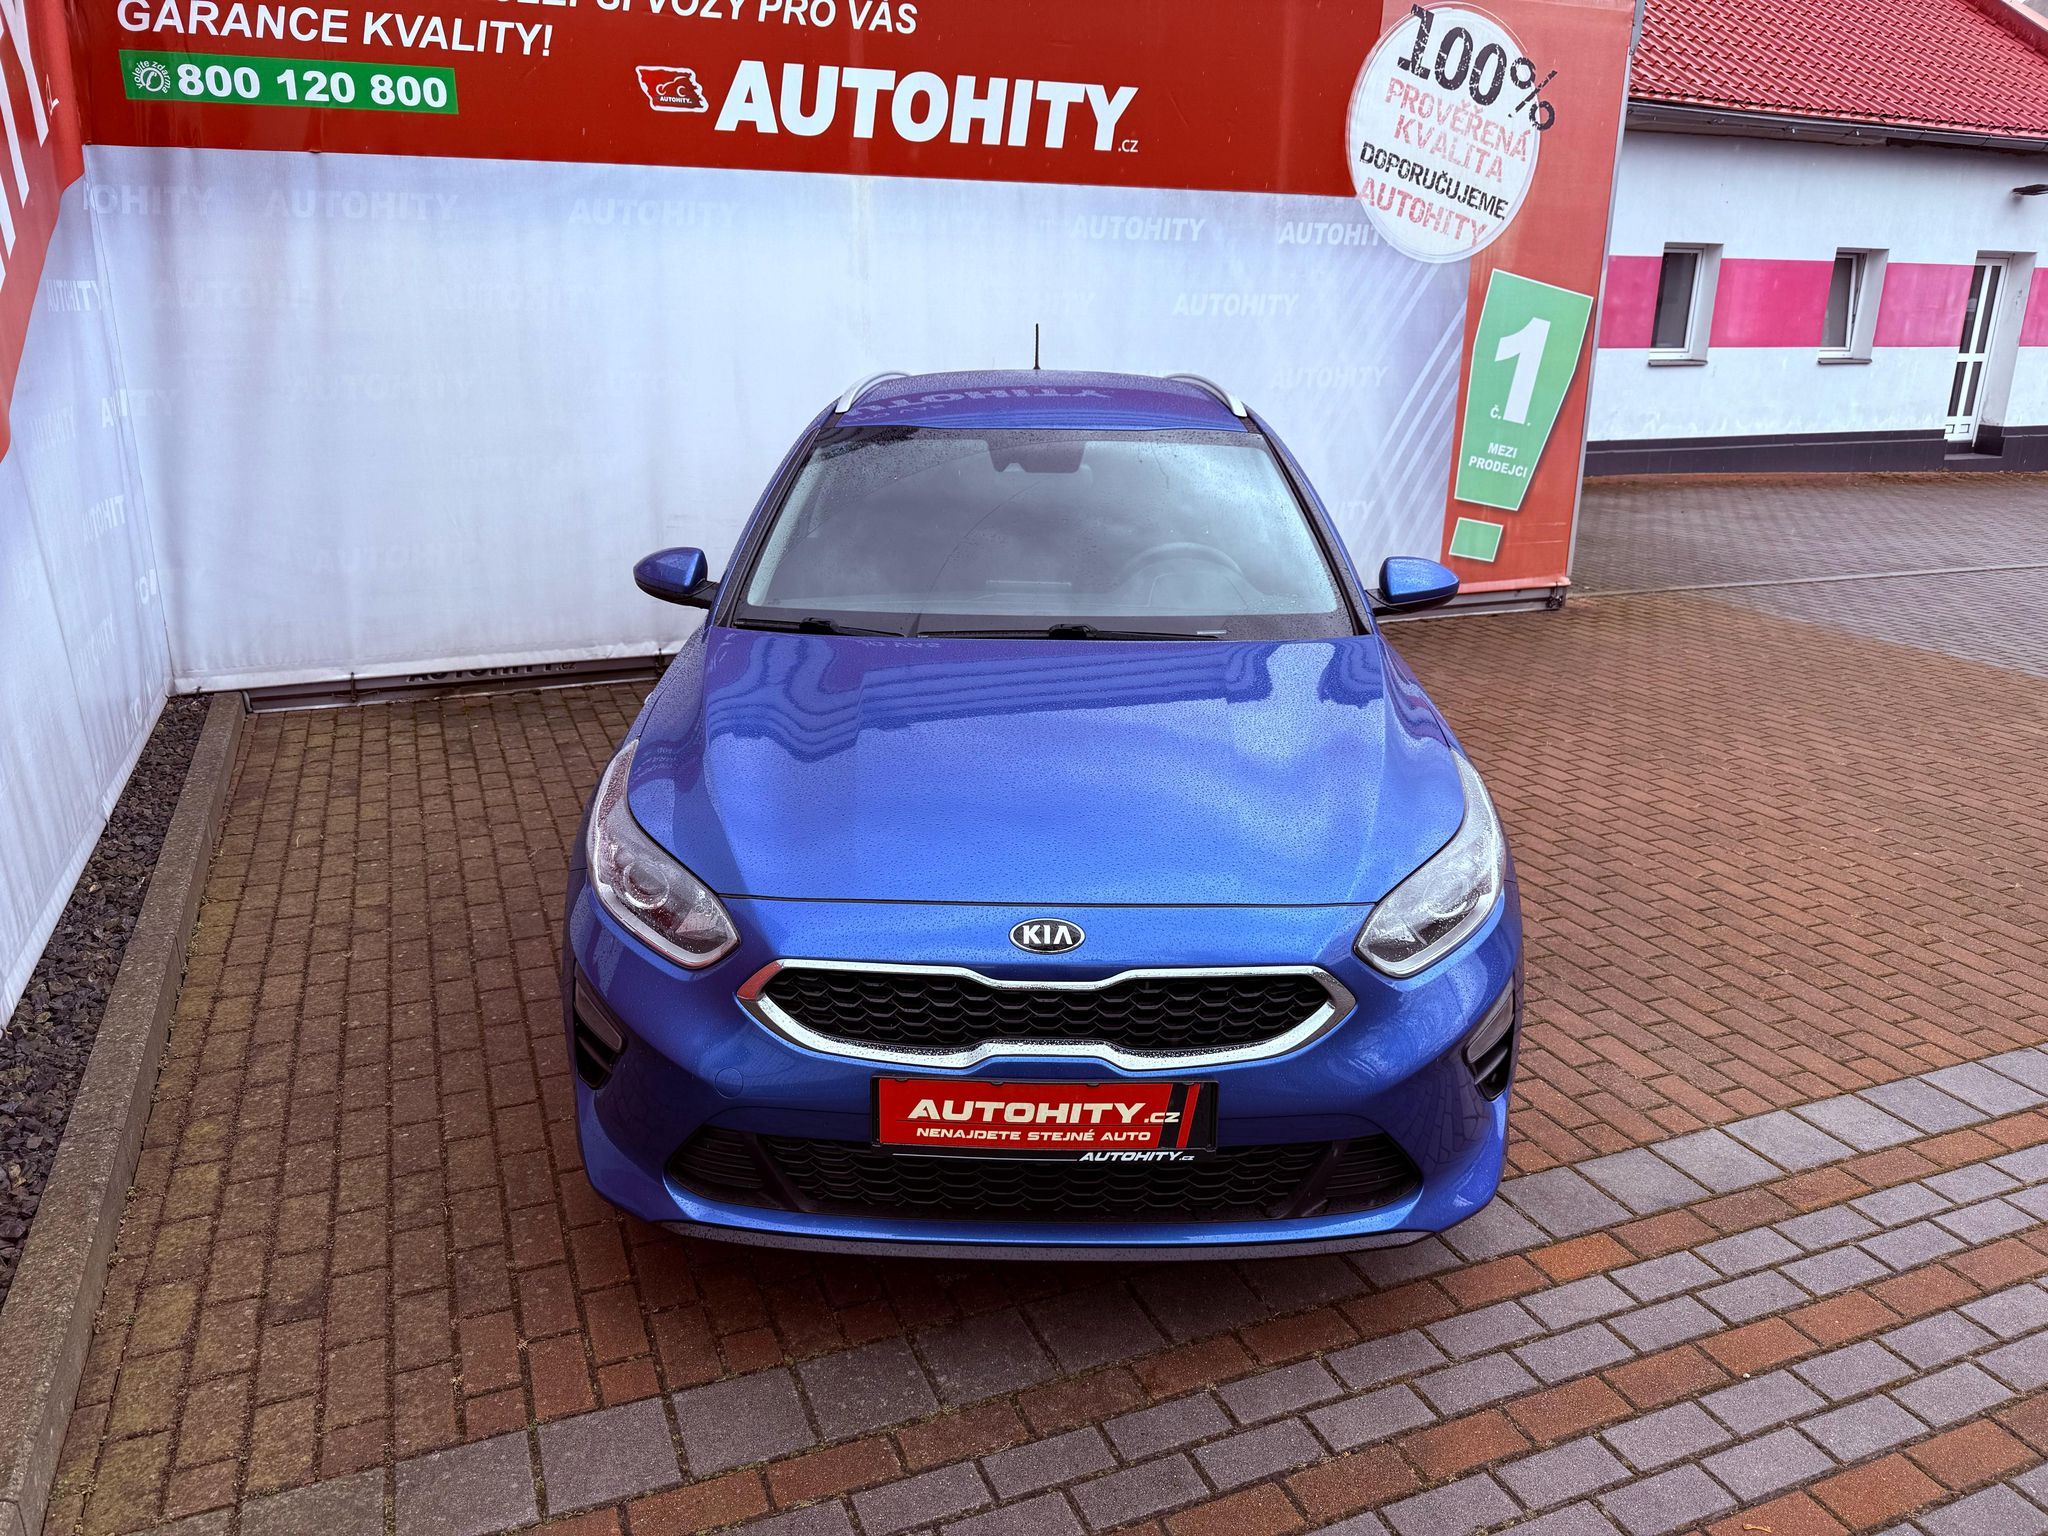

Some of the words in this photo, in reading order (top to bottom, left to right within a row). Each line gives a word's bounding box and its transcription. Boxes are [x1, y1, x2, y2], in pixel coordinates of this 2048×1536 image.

[116, 0, 349, 43] GARANCE
[362, 11, 554, 56] KVALITY!
[757, 0, 836, 28] PRO
[848, 0, 918, 34] VÁS
[1397, 3, 1558, 131] 100%
[177, 63, 260, 98] 800
[276, 69, 355, 103] 120
[370, 74, 447, 107] 800
[1385, 77, 1531, 162] PROVĚŘENÁ
[1393, 115, 1503, 183] KVALITA
[1359, 141, 1509, 220] DOPORUČUJEME
[1069, 215, 1207, 242] AUTOHITY
[1359, 177, 1488, 247] AUTOHITY
[1279, 221, 1390, 247] AUTOHIT
[1172, 293, 1299, 317] AUTOHITY
[1468, 455, 1528, 478] PRODEJCI
[1487, 441, 1518, 459] MEZI
[1022, 924, 1073, 944] KIA
[916, 1127, 1021, 1141] NENAJDETE
[1027, 1128, 1096, 1142] STEJNÉ
[1100, 1130, 1151, 1142] AUTO
